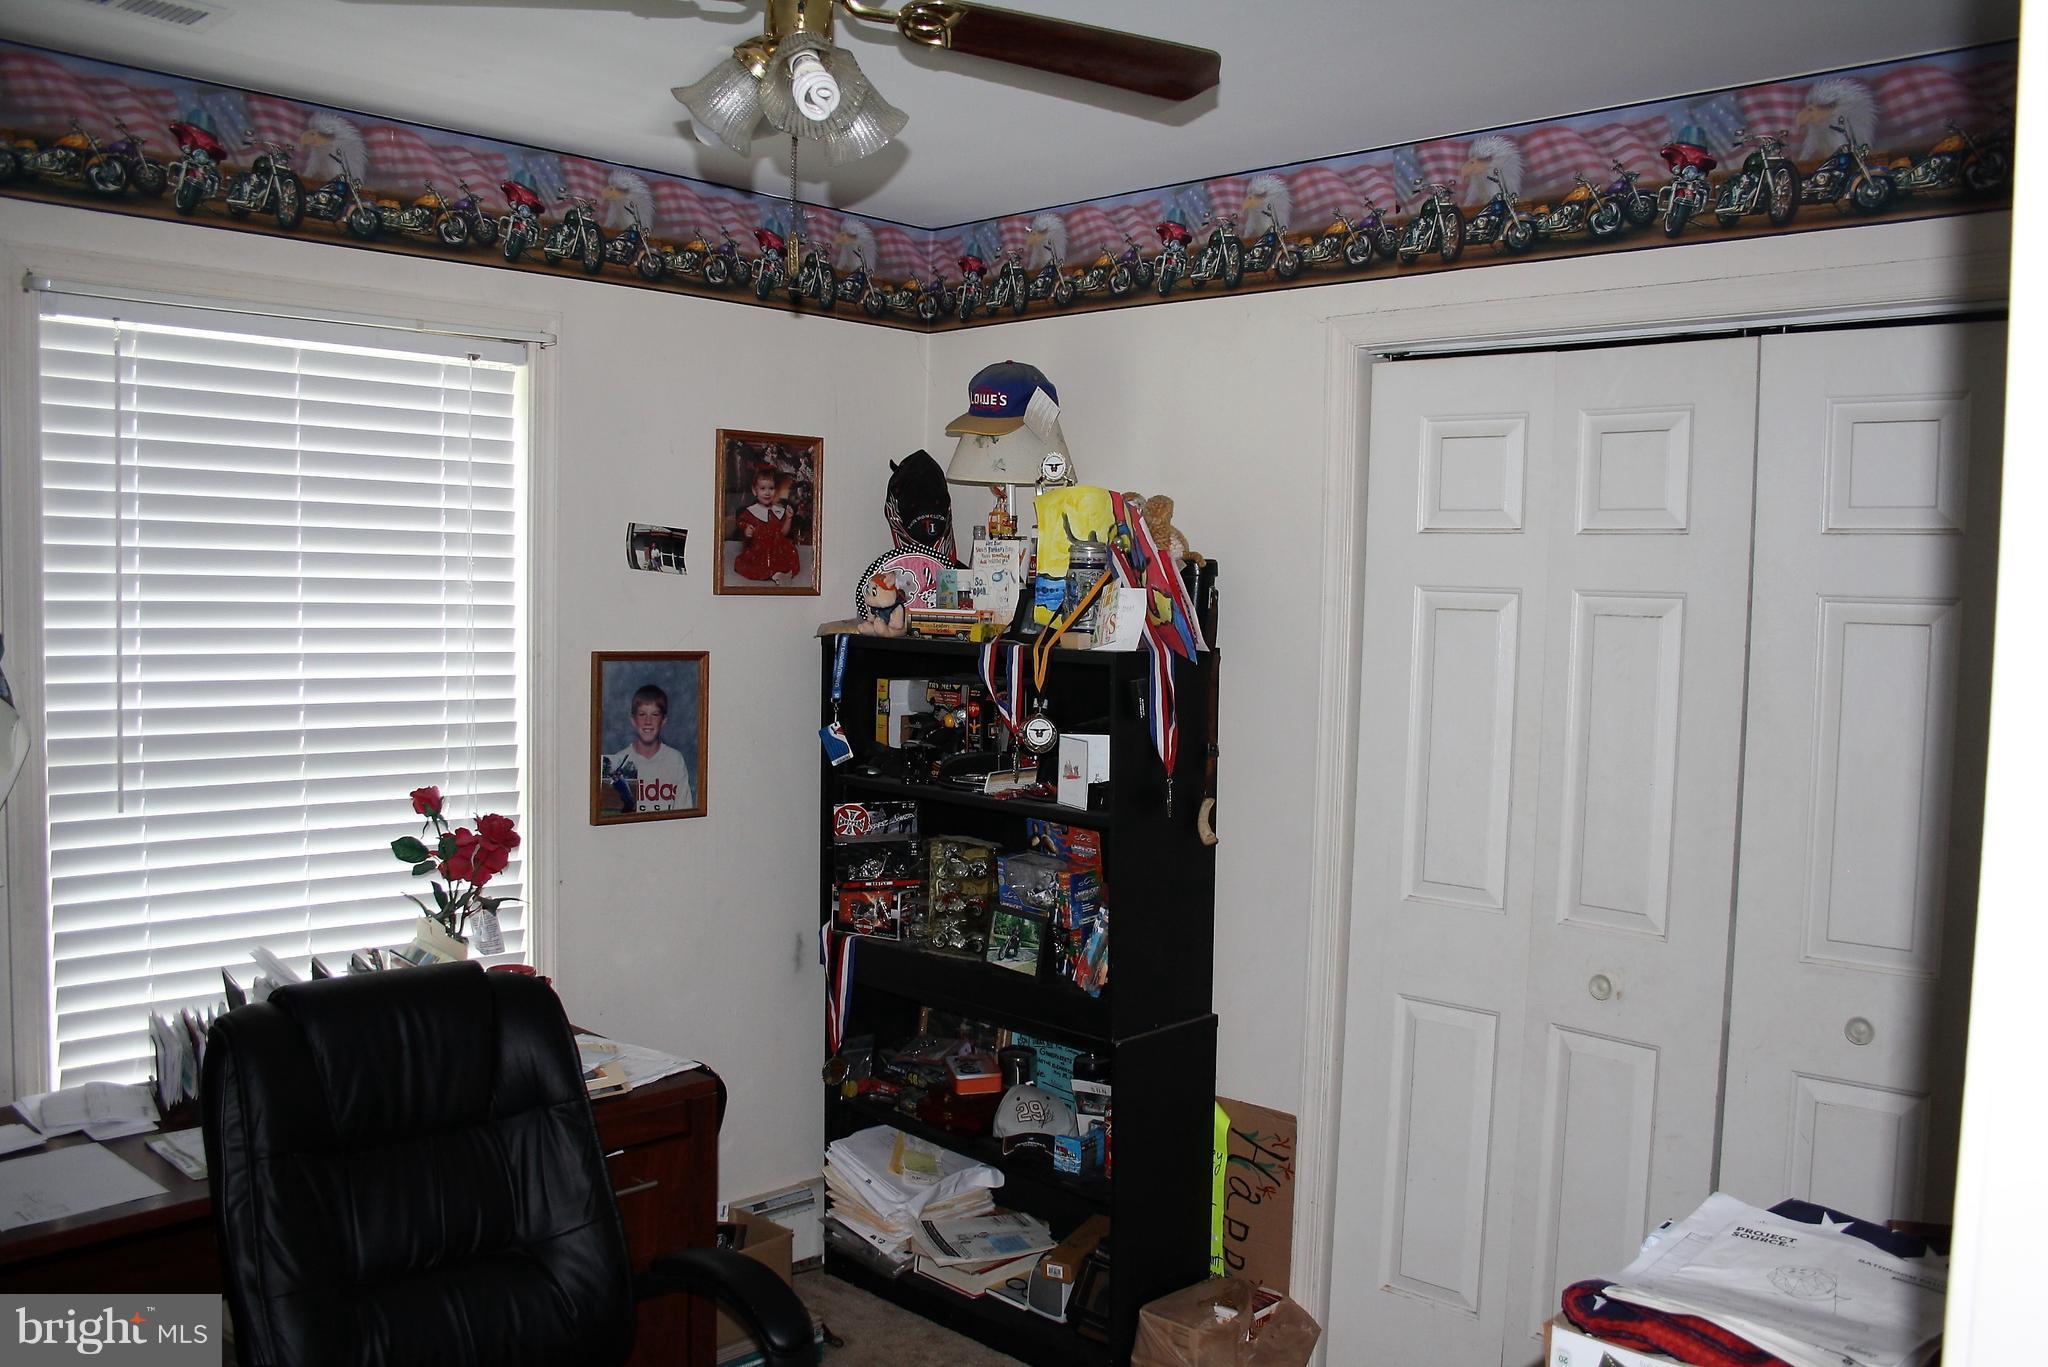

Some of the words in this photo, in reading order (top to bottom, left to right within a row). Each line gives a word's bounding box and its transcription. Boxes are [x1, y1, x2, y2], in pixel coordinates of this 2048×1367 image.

[970, 391, 1008, 407] LOWE'S
[1016, 1100, 1046, 1123] 29
[1735, 1226, 1798, 1243] PROJECT
